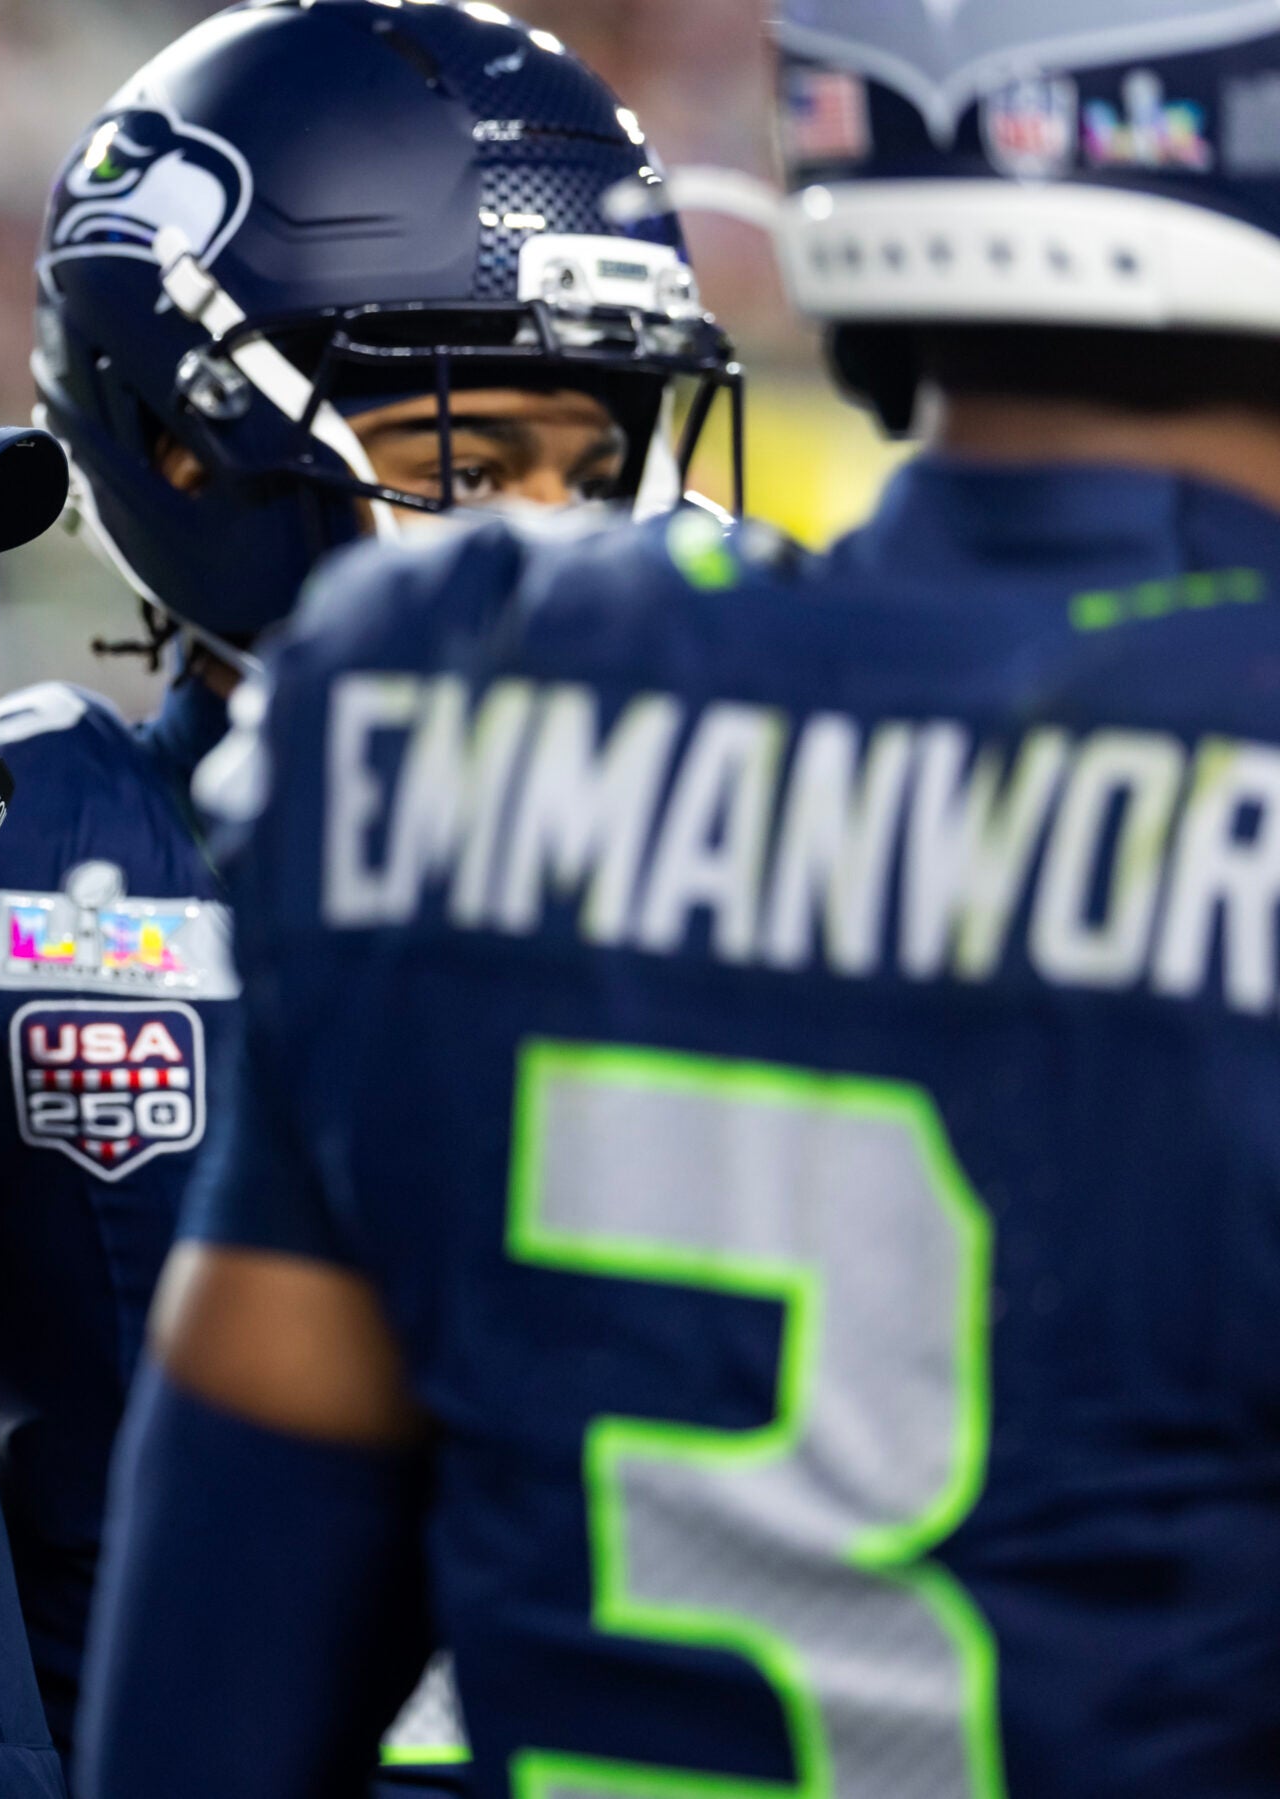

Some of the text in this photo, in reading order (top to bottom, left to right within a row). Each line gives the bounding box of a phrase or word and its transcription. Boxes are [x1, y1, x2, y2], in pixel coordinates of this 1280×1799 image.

[28, 1021, 183, 1065] USA
[28, 1090, 194, 1138] 250
[505, 1034, 1007, 1799] 3
